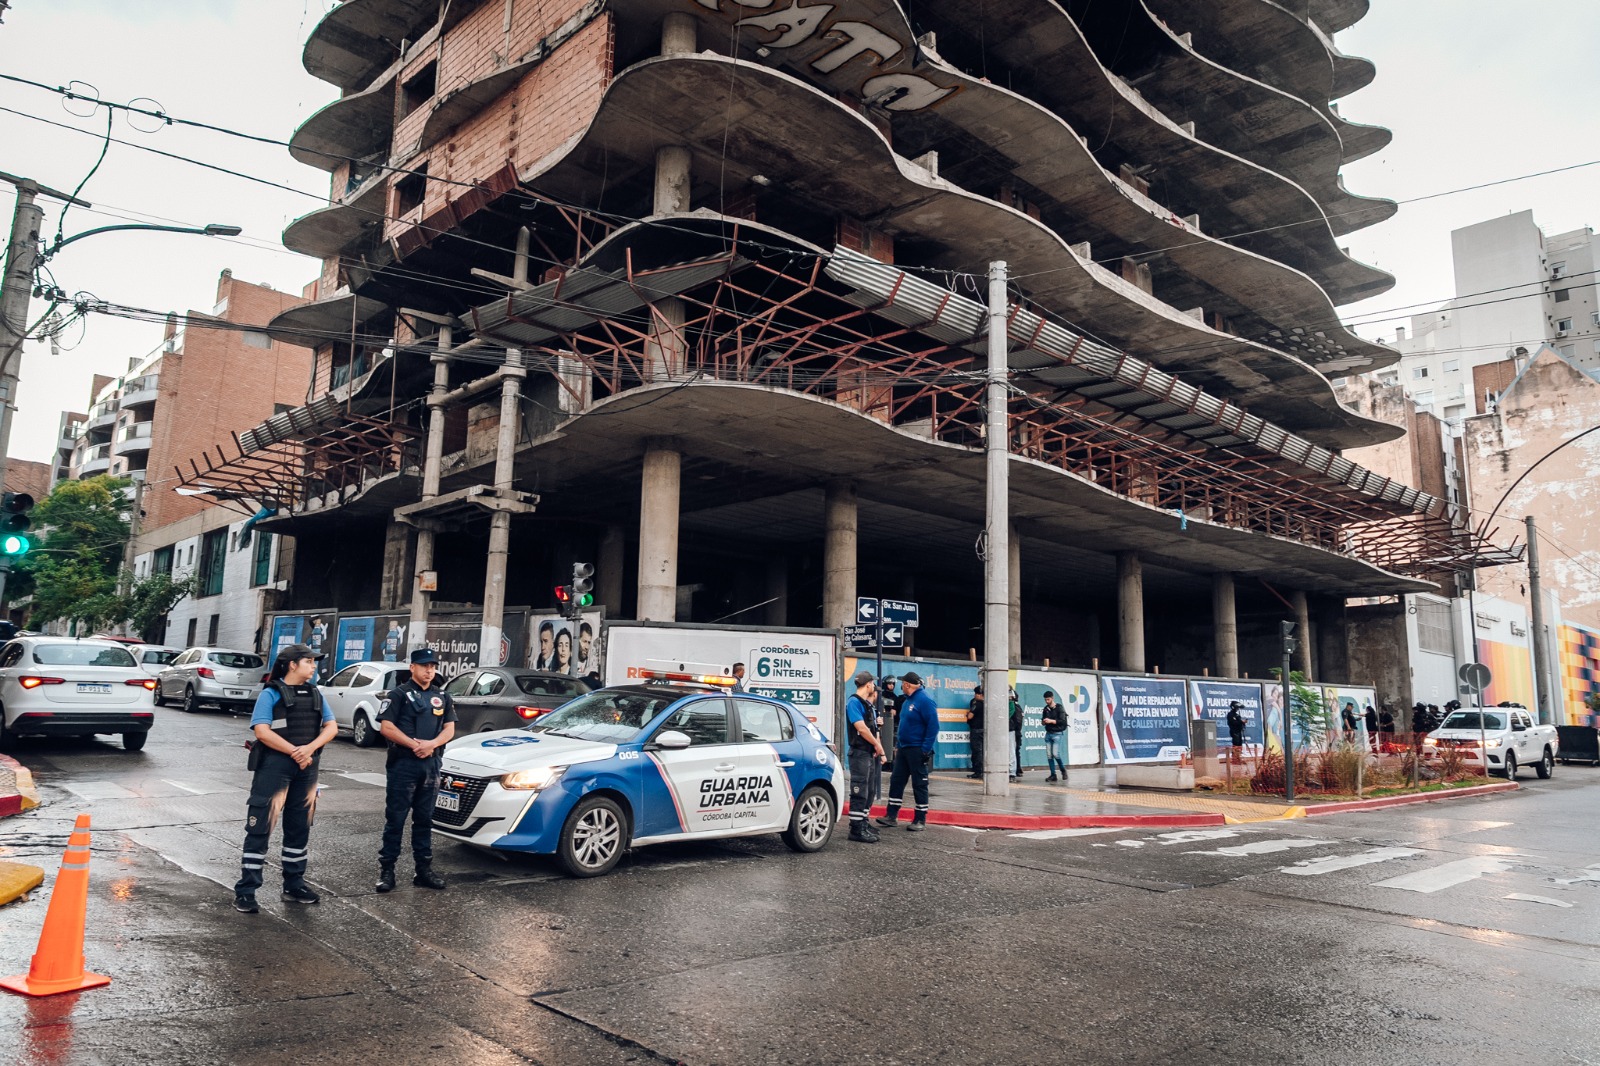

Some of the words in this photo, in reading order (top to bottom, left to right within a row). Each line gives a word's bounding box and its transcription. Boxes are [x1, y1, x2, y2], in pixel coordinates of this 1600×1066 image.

[892, 602, 902, 610] San
[855, 626, 865, 634] José
[441, 640, 450, 653] tu
[451, 640, 478, 654] futuro
[757, 657, 771, 677] 6
[773, 658, 792, 668] SIN
[772, 667, 813, 678] INTERÉS
[791, 690, 813, 702] 15%
[1122, 695, 1138, 705] PLAN
[1139, 696, 1147, 705] DE
[1148, 693, 1182, 705] REPARACIÓN
[1206, 698, 1221, 706] PLAN
[1122, 708, 1127, 717] Y
[1128, 708, 1151, 717] PUESTA
[1152, 708, 1160, 717] EN
[1160, 708, 1179, 717] VALOR
[1123, 720, 1130, 728] DE
[1131, 720, 1153, 728] CALLES
[1159, 719, 1180, 728] PLAZAS
[700, 775, 773, 793] GUARDIA
[700, 790, 770, 808] URBANA
[702, 812, 732, 822] CÓRDOBA
